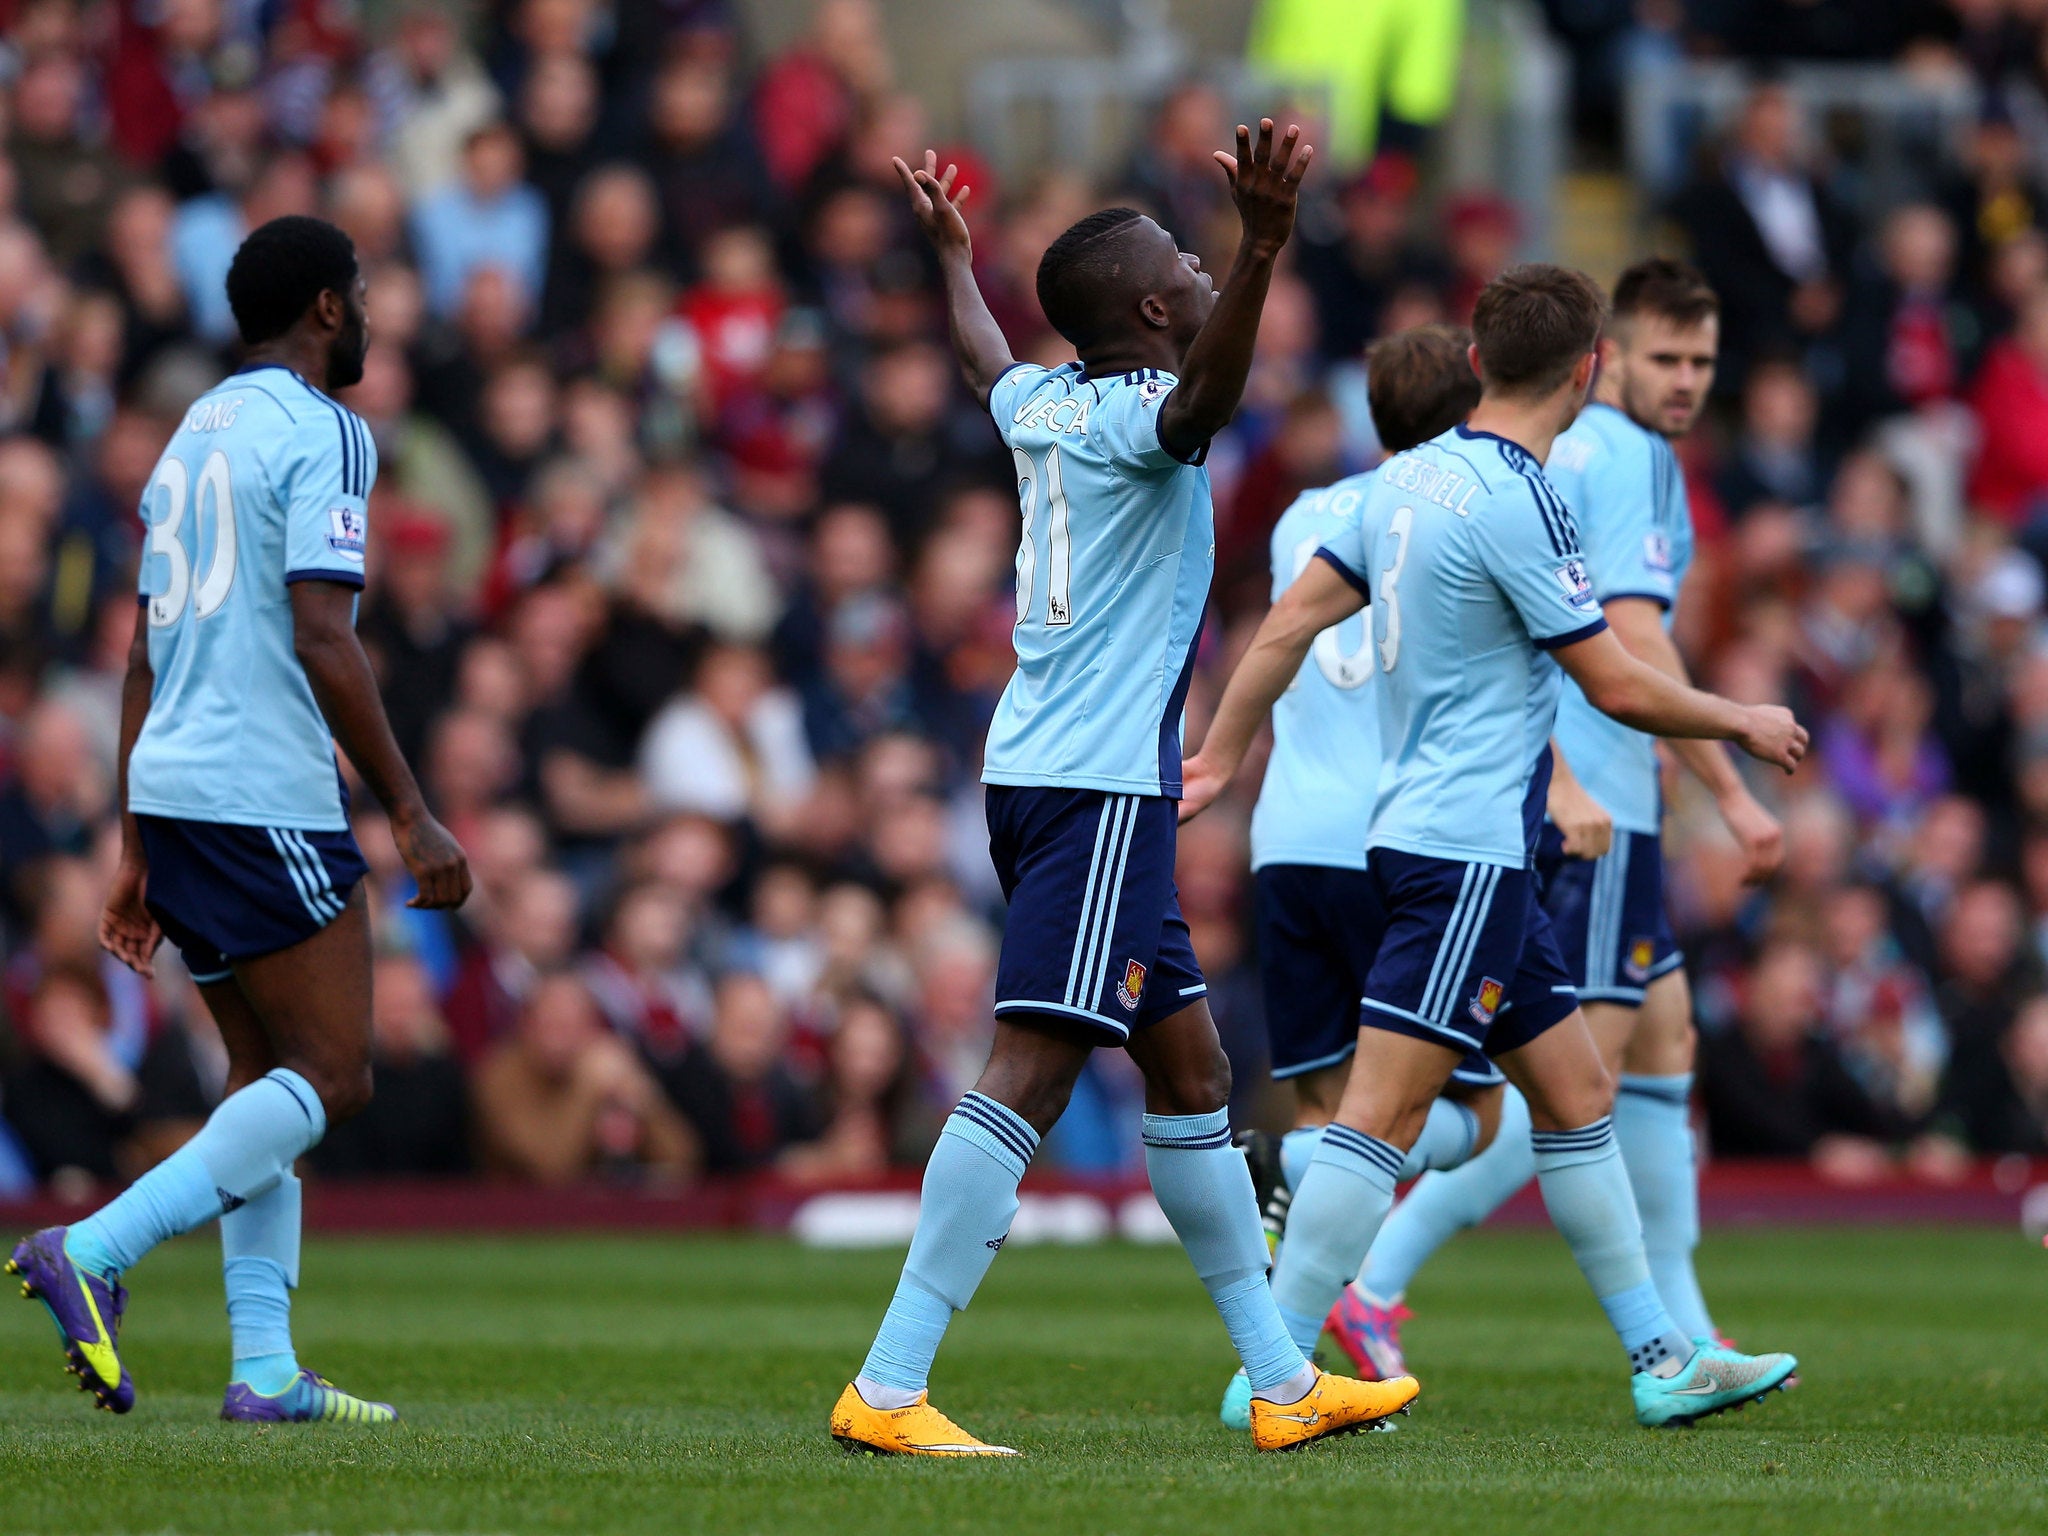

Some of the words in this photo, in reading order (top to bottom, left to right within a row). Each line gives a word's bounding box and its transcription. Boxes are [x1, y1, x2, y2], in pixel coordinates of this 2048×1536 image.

[147, 450, 237, 627] 30
[1012, 442, 1071, 626] 31
[1377, 505, 1414, 673] 3
